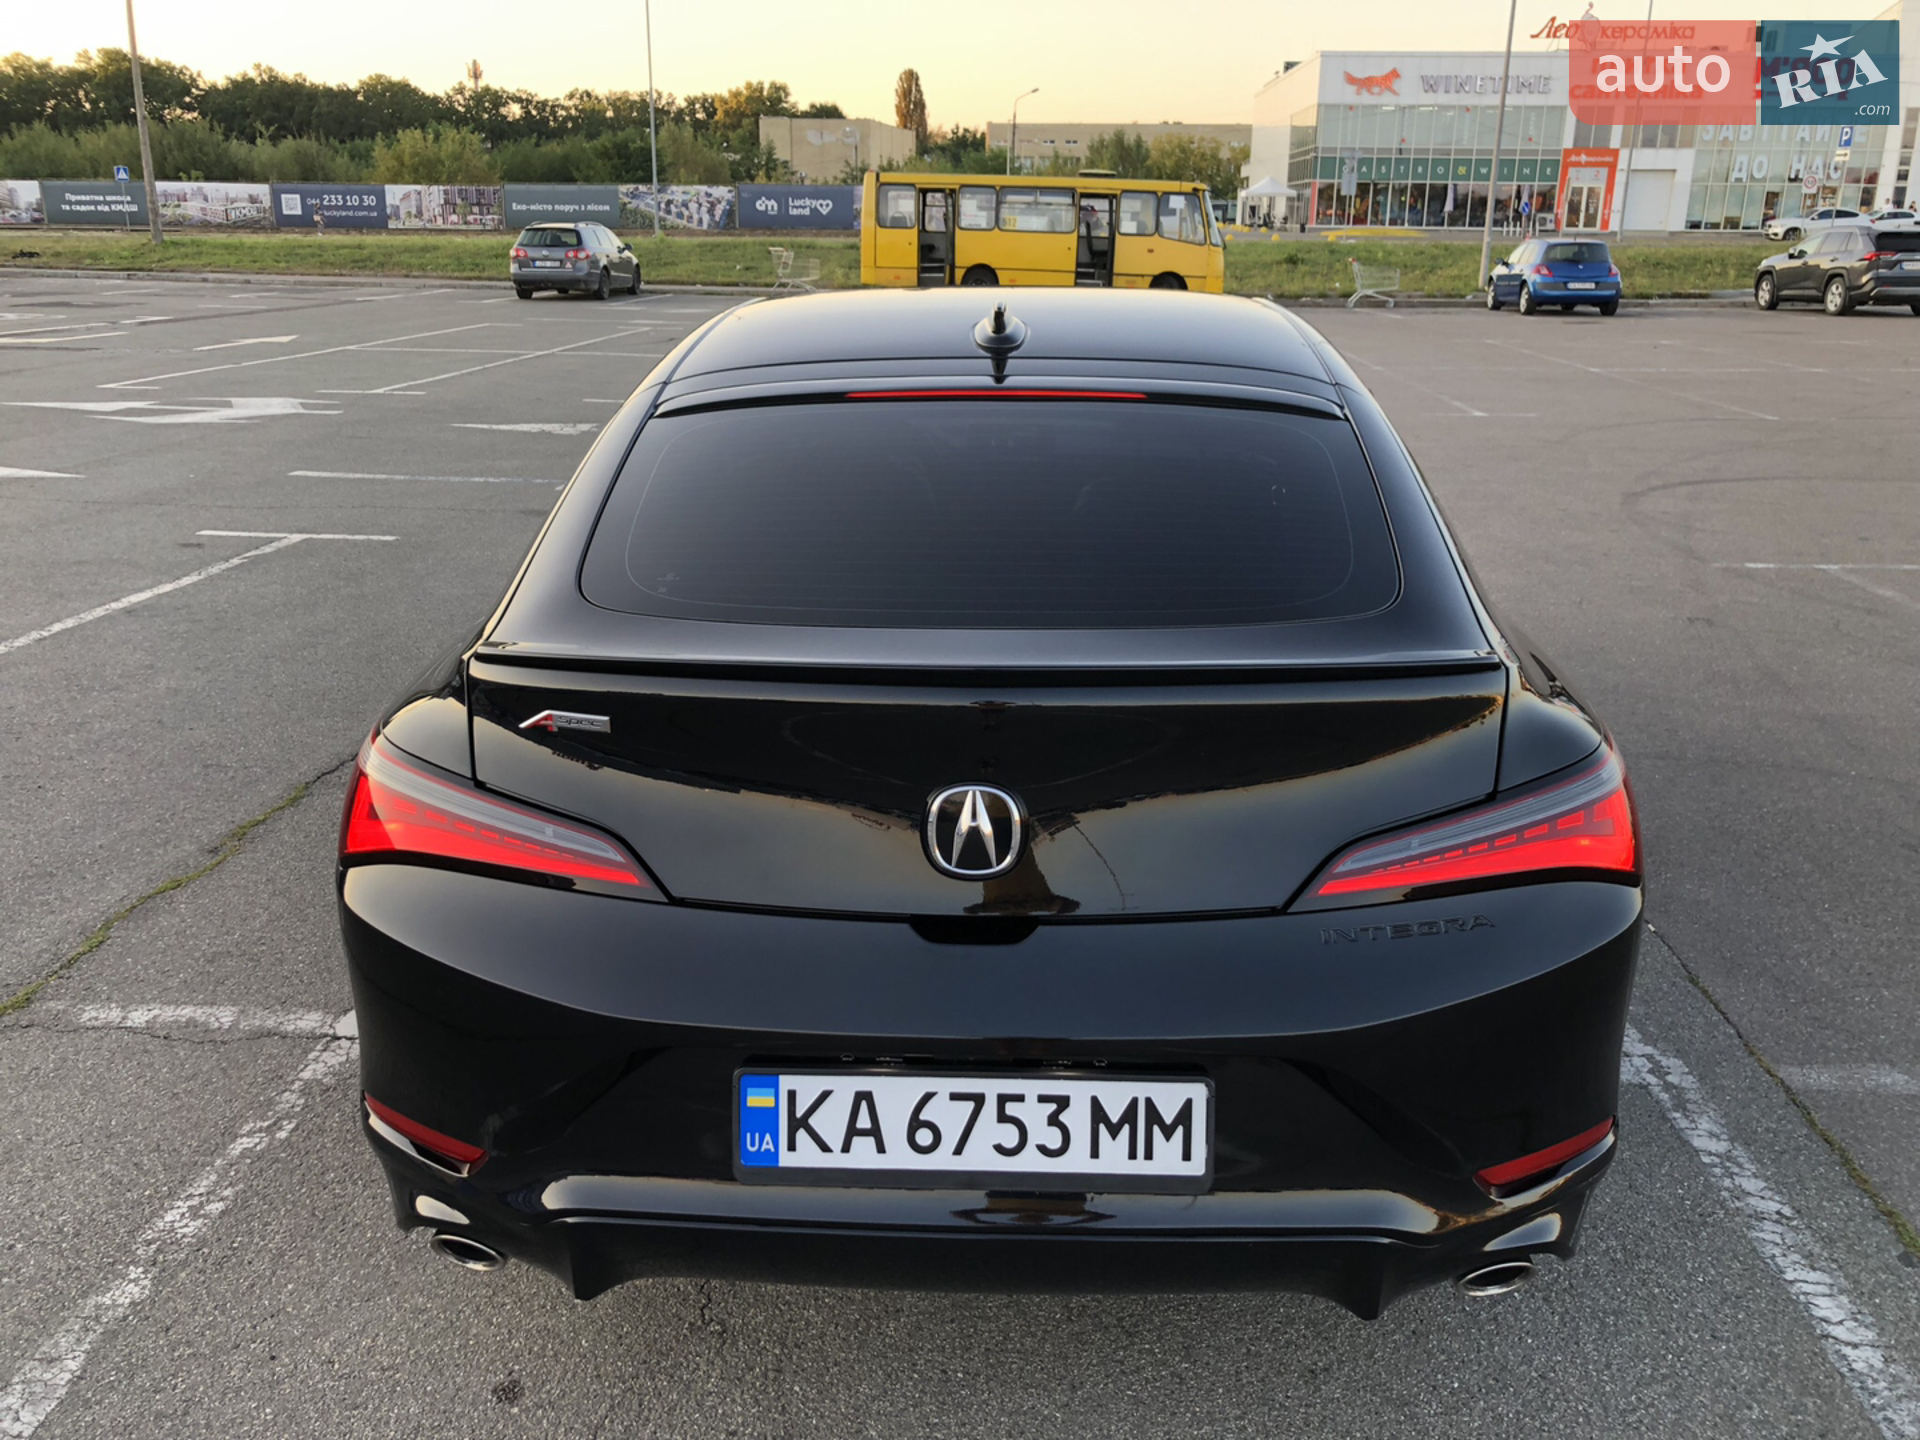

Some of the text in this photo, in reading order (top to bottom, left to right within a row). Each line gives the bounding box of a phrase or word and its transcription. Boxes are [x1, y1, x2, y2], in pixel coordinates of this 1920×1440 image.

[1530, 16, 1579, 39] Лео
[1420, 74, 1551, 94] WINETIME
[1479, 166, 1551, 176] WINE
[1730, 154, 1843, 183] ДО НАС
[64, 192, 104, 202] Приватна
[322, 194, 344, 206] 233
[345, 195, 360, 206] 10
[362, 195, 377, 206] 30
[788, 196, 817, 208] Lucky
[323, 209, 378, 217] luckyland.com.ua
[511, 202, 553, 211] Еко-місто
[554, 204, 579, 213] поруч
[586, 202, 611, 211] лісом
[1319, 912, 1496, 945] INTEGRA
[786, 1088, 1194, 1162] KA 6753 MM
[746, 1132, 775, 1153] UA
